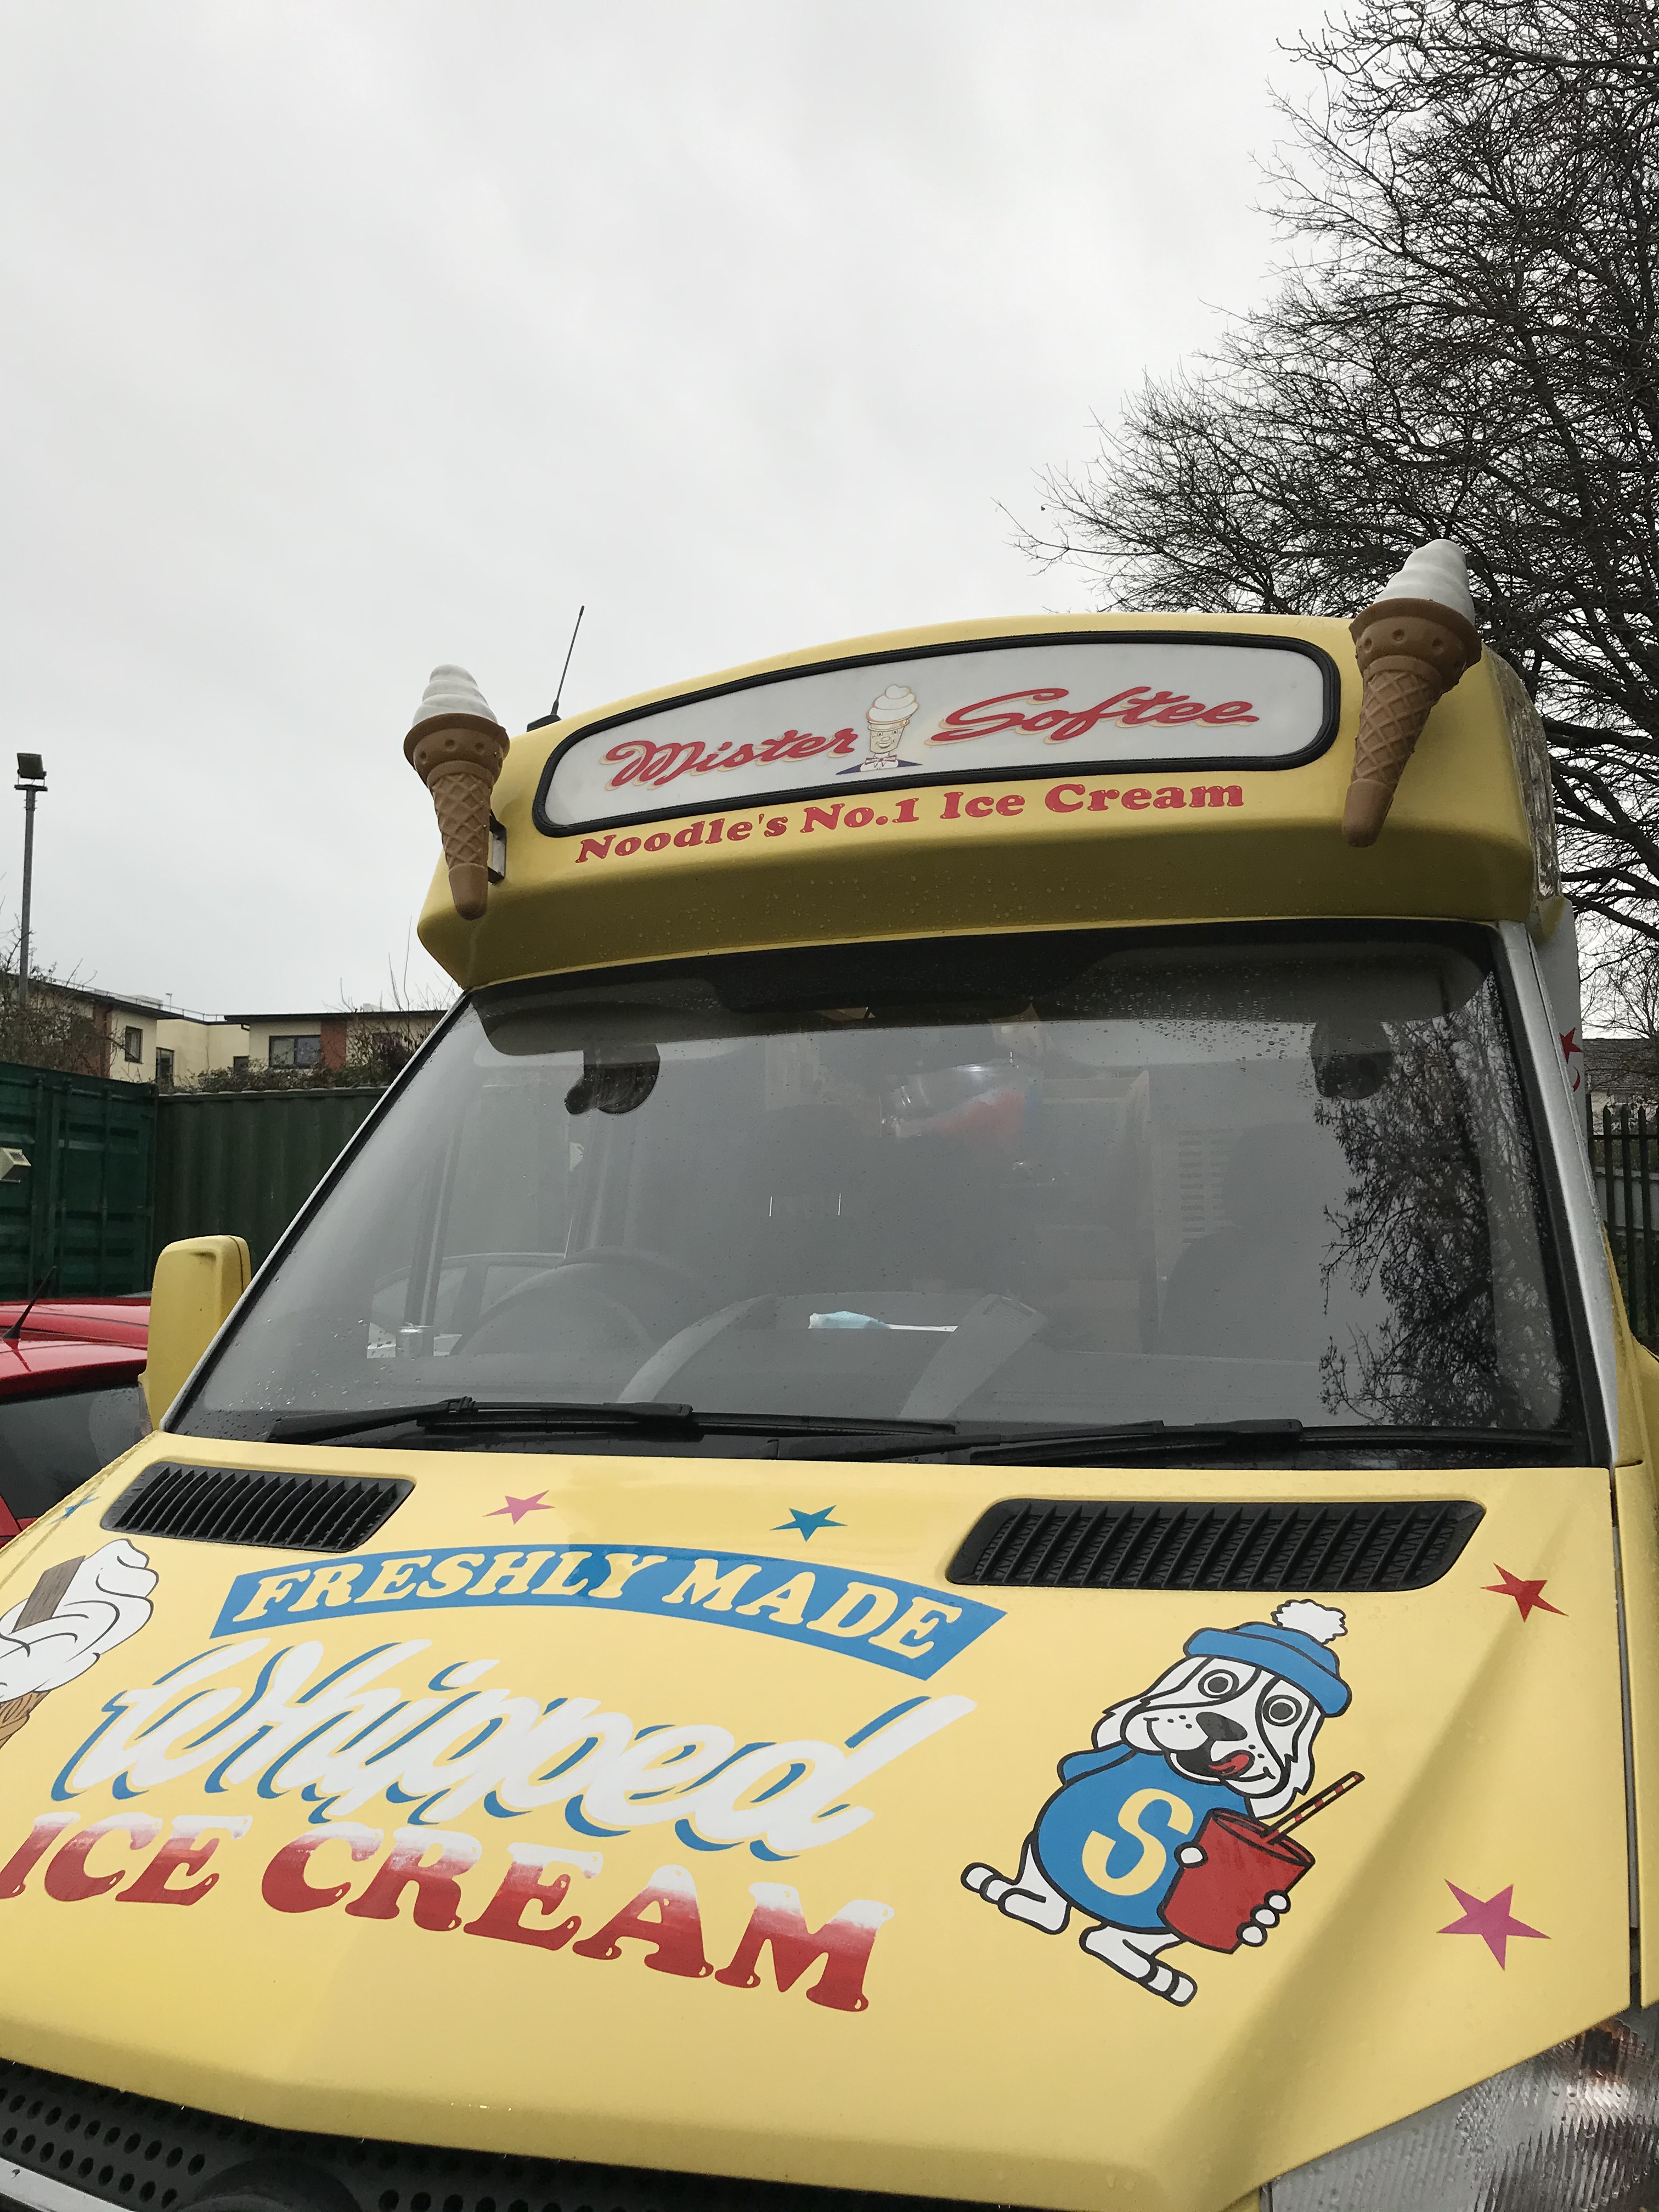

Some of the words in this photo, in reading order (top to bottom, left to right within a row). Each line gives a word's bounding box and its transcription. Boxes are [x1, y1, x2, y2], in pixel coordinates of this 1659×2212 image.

[600, 727, 859, 791] Mister
[925, 686, 1260, 746] Softee
[574, 813, 788, 864] Noodle's
[799, 797, 919, 833] No.1
[939, 791, 1026, 820] Ice
[1045, 783, 1244, 814] Cream
[233, 1550, 667, 1622] FRESHLY
[661, 1558, 962, 1660] MADE
[50, 1638, 978, 1861] Whipped
[1081, 1787, 1194, 1896] S
[0, 1812, 253, 1906] ICE
[261, 1821, 895, 2012] CREAM
